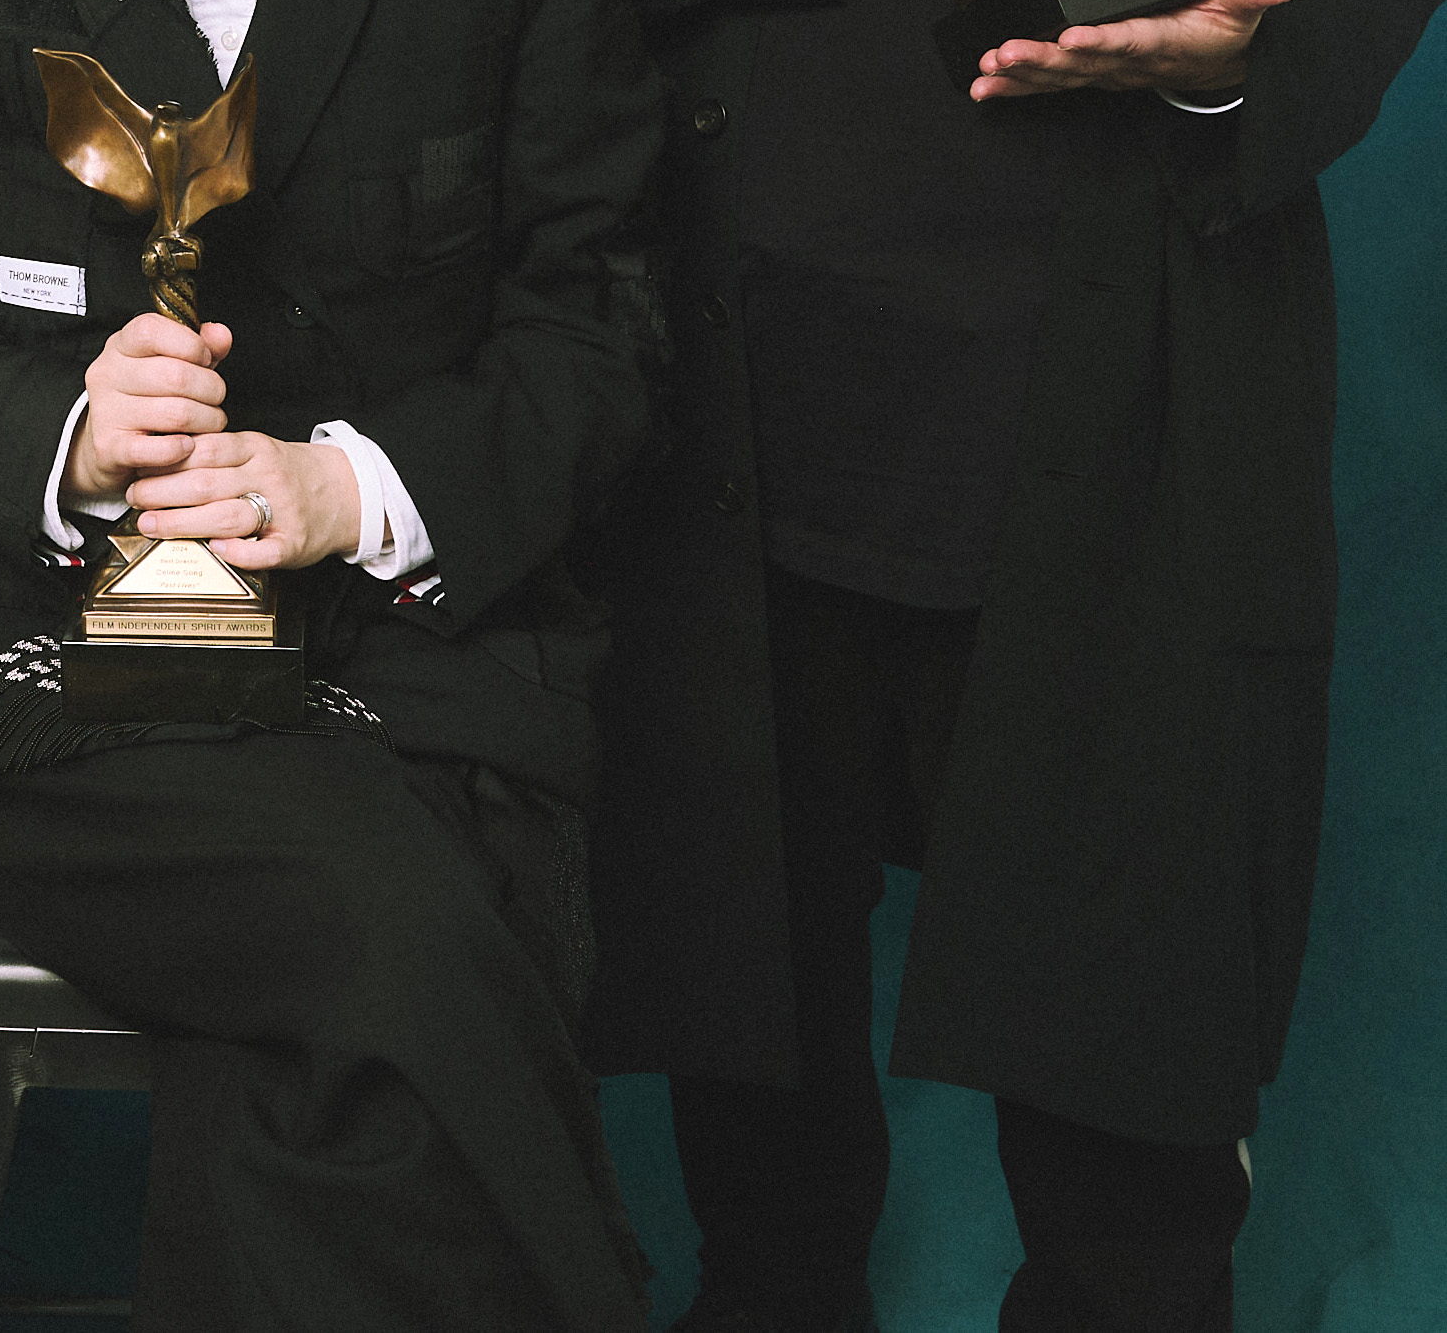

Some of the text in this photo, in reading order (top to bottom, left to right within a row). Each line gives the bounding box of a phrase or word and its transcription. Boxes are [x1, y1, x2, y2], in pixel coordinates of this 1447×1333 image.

[8, 270, 31, 282] THOM
[156, 568, 203, 578] Celine Song
[92, 621, 267, 632] FILM INDEPENDENT SPIRIT AWARDS
